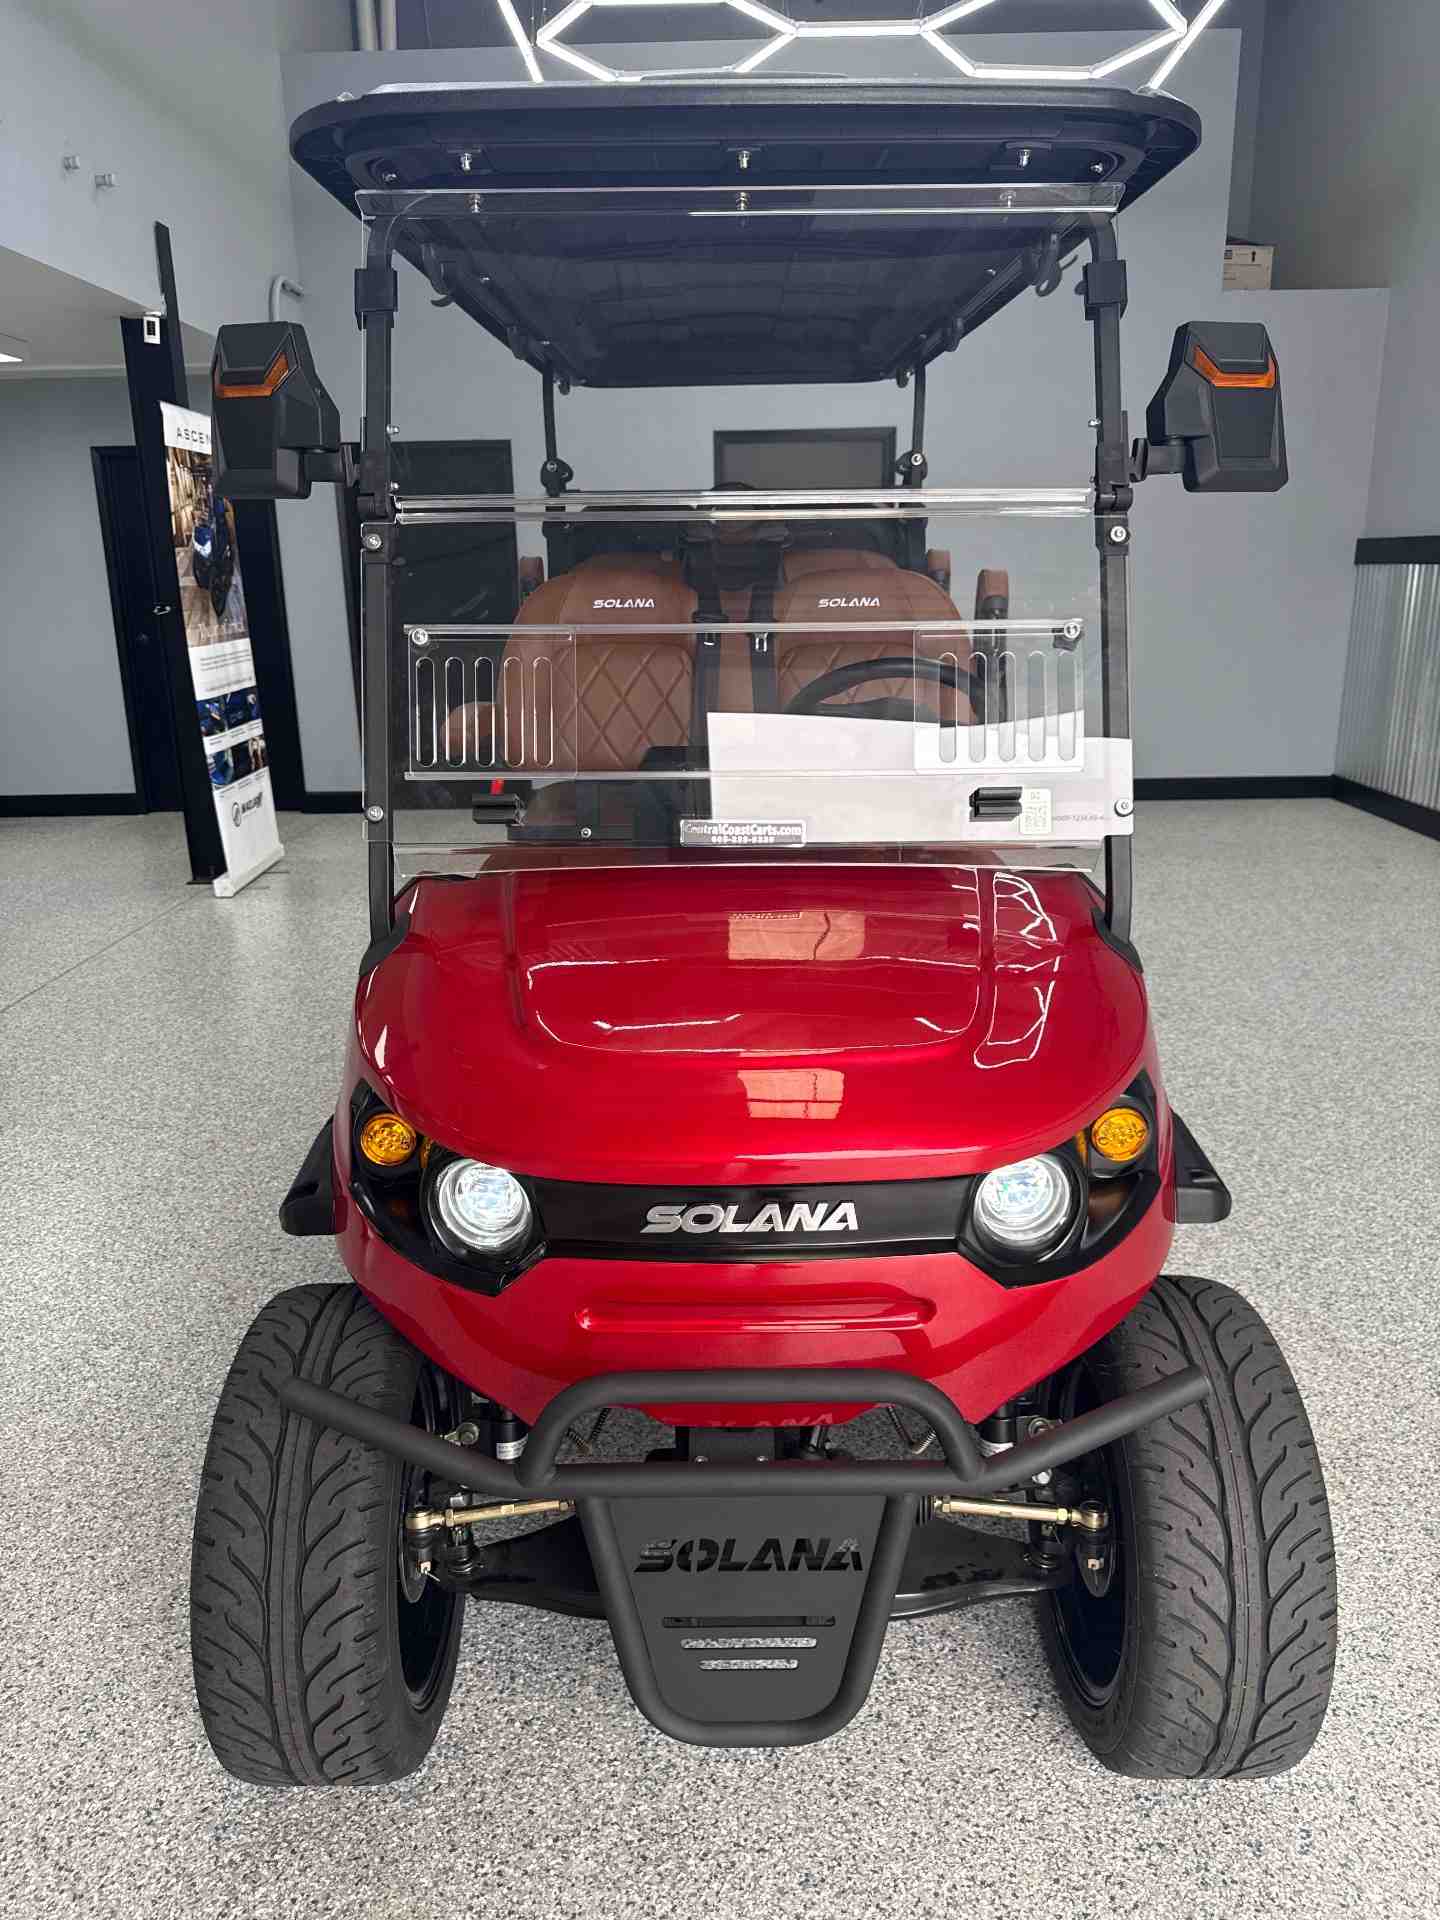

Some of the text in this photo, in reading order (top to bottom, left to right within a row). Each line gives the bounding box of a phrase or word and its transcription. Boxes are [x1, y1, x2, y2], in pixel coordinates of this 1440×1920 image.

[592, 597, 655, 609] SOLANA
[818, 596, 881, 608] SOLANA
[640, 1203, 859, 1234] SOLANA
[633, 1536, 864, 1573] SOLANA
